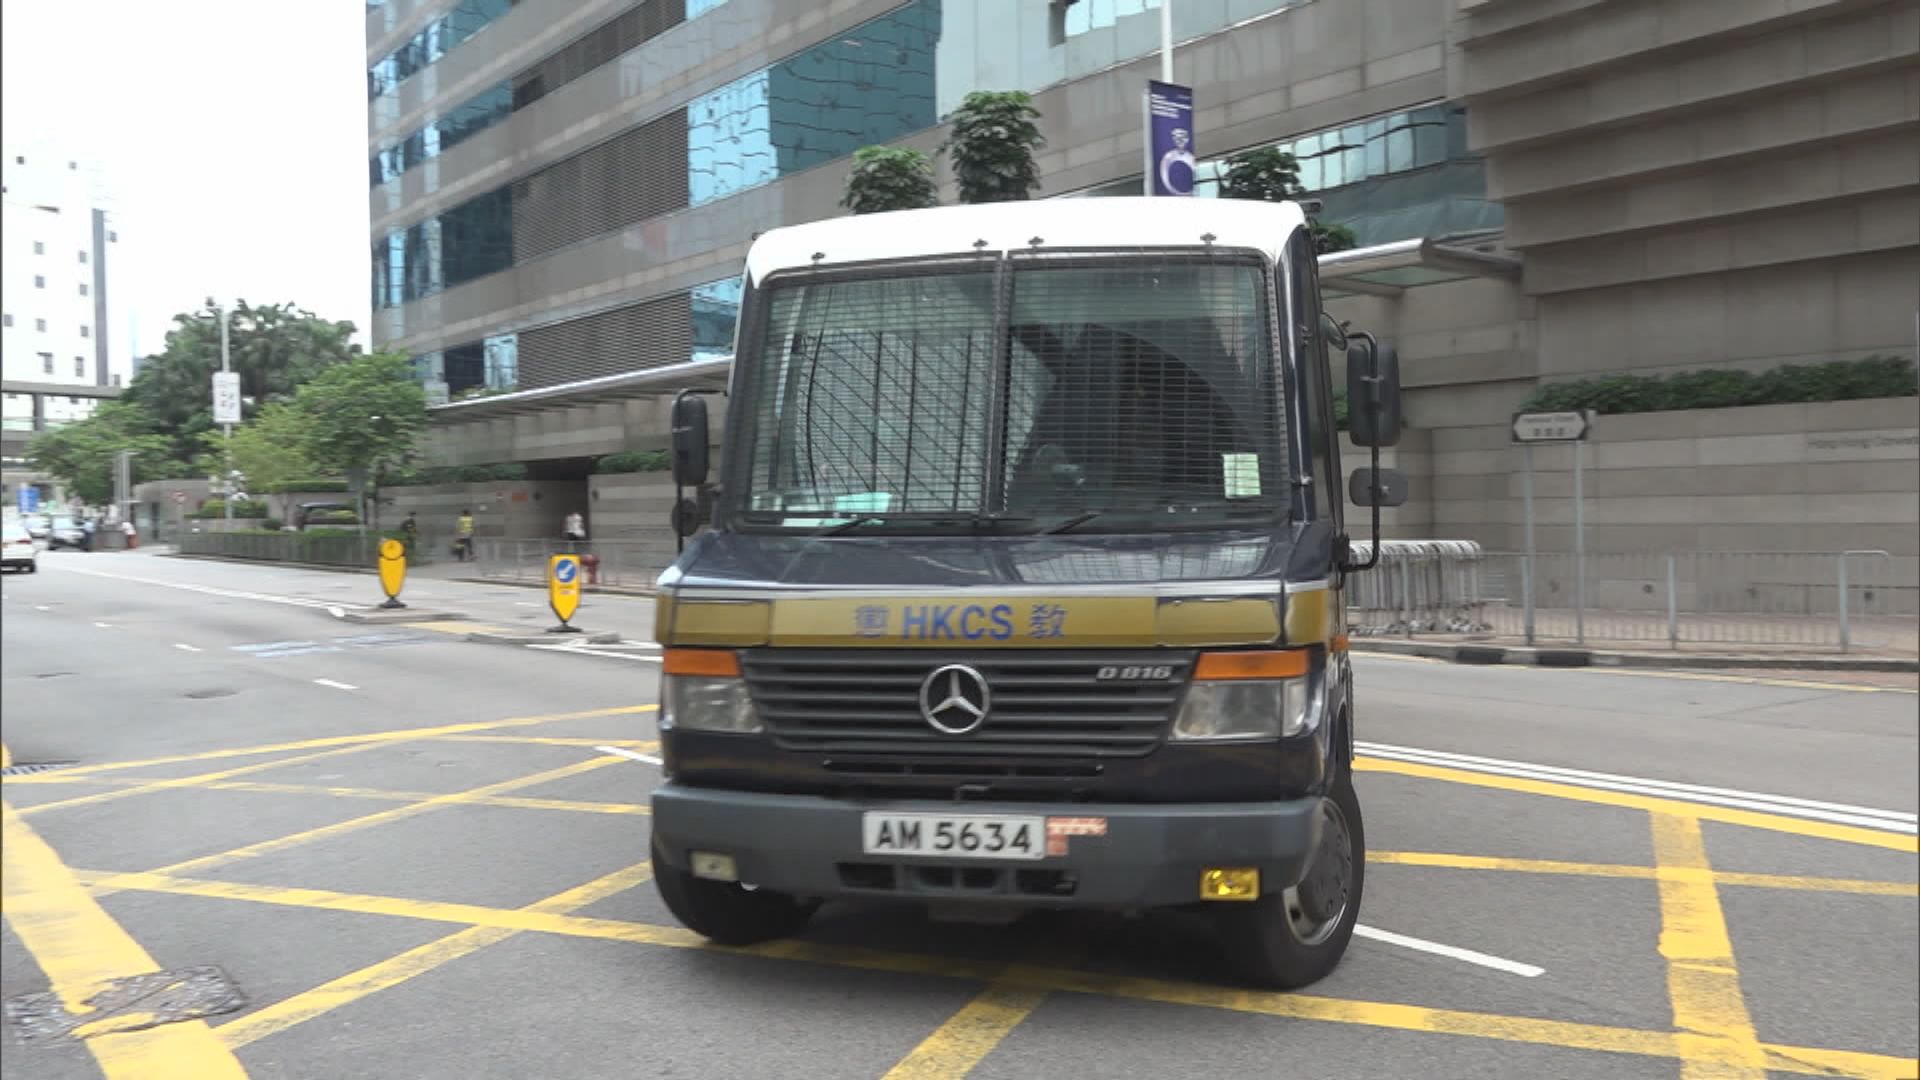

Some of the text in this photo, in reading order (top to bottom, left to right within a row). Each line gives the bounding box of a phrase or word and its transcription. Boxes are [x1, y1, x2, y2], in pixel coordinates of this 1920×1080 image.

[902, 604, 1013, 640] HKCS
[875, 819, 922, 850] AM
[932, 821, 1032, 853] 5634
